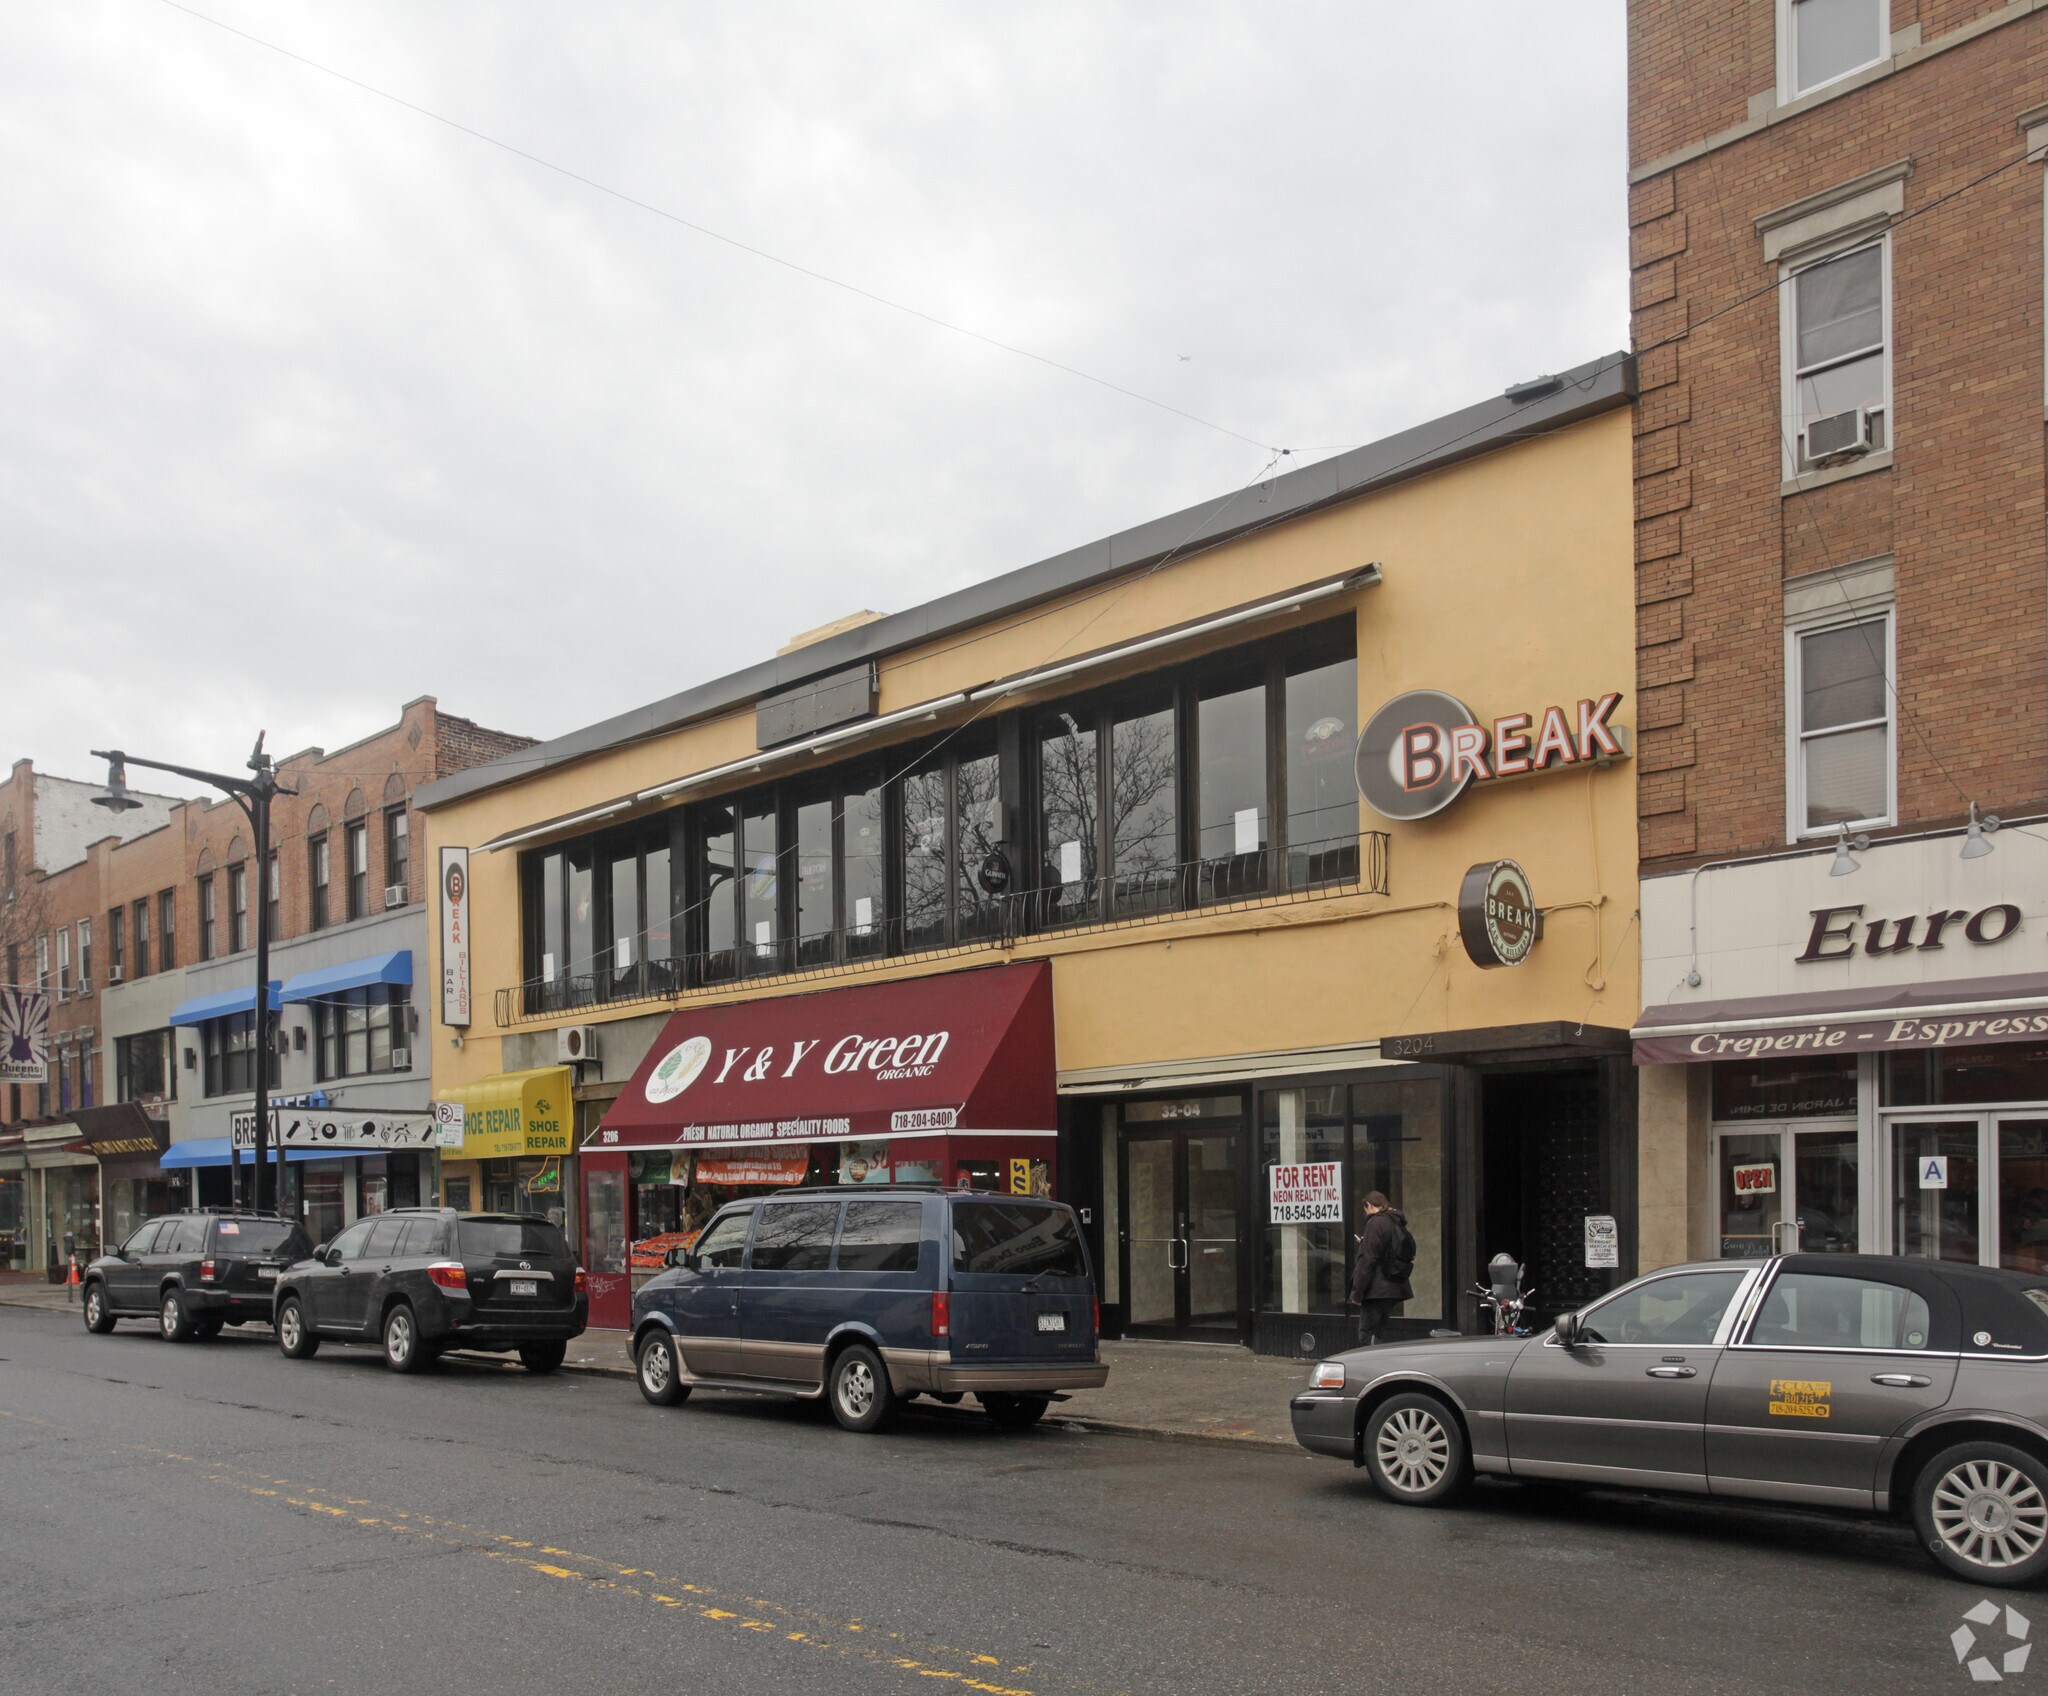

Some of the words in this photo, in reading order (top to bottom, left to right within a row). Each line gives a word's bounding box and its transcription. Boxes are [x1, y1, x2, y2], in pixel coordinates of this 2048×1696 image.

[1402, 692, 1624, 792] BREAK
[452, 876, 461, 943] BREAK
[1489, 898, 1531, 929] BREAK
[1795, 903, 2022, 963] Euro
[446, 968, 454, 995] BAR
[459, 952, 467, 1014] BILLIARDS
[1393, 1036, 1434, 1056] 3204
[1690, 1026, 1847, 1057] Creperie
[1885, 1014, 2048, 1046] Espress
[713, 1046, 751, 1084] Y
[743, 1046, 773, 1082] &
[781, 1039, 820, 1078] Y
[823, 1030, 949, 1075] Green
[876, 1064, 935, 1080] ORGANIC
[464, 1111, 484, 1136] HOE
[486, 1107, 521, 1133] REPAIR
[894, 1111, 953, 1128] 718-204-6400
[1161, 1104, 1200, 1118] 32-04
[234, 1114, 274, 1145] BREK
[529, 1120, 559, 1132] SHOE
[602, 1130, 619, 1143] 3206
[683, 1126, 704, 1141] FRESH
[707, 1123, 739, 1140] NATURAL
[739, 1122, 774, 1139] ORGANIC
[776, 1119, 821, 1137] SPECIALITY
[822, 1117, 850, 1135] FOODS
[527, 1136, 567, 1149] REPAIR
[1275, 1166, 1299, 1189] FOR
[1303, 1164, 1335, 1187] RENT
[1735, 1168, 1772, 1190] OPEN
[1925, 1160, 1942, 1180] A
[1273, 1190, 1293, 1203] NEON
[1295, 1189, 1322, 1202] REALTY
[1324, 1188, 1339, 1201] INC.
[1273, 1204, 1339, 1221] 718-545-8474
